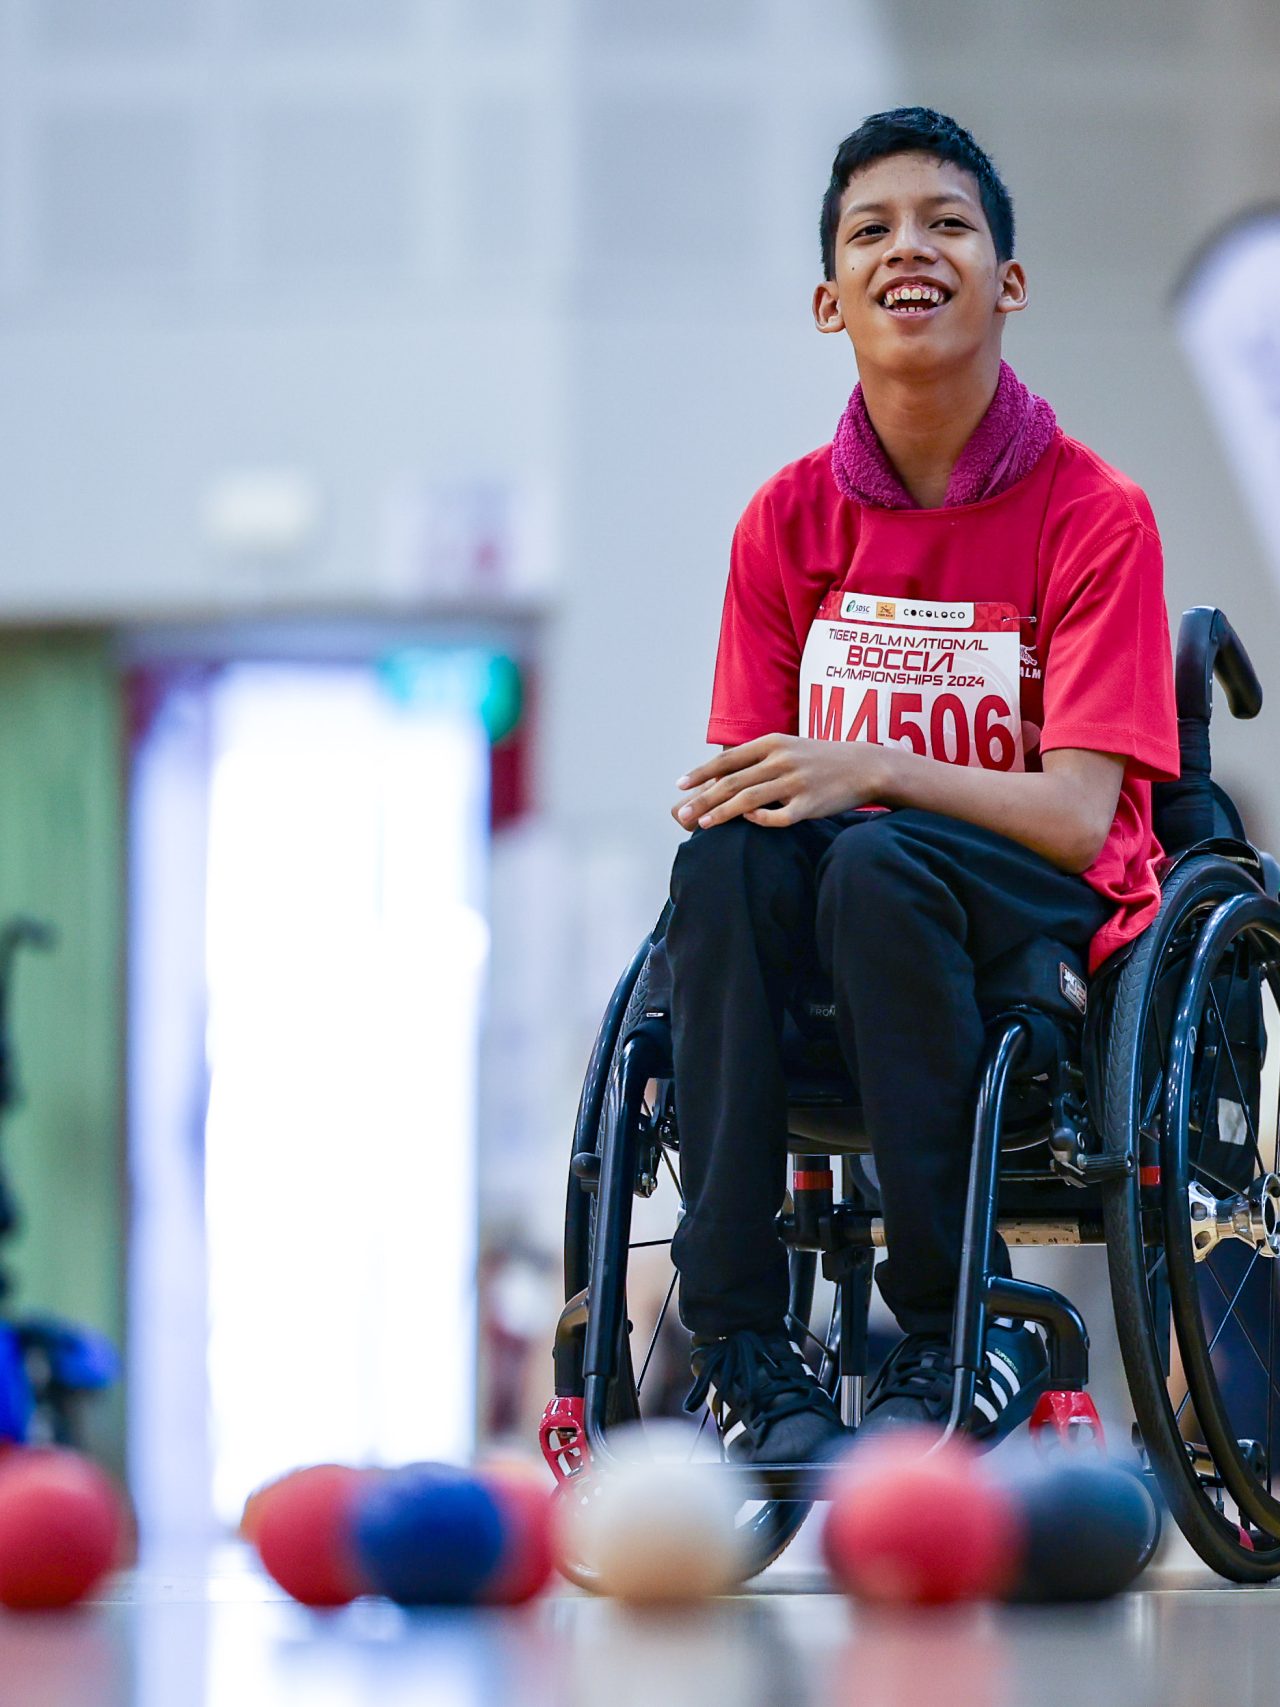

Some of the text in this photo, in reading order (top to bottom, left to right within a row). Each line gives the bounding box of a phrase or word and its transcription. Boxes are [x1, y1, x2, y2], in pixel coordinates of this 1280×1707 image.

[903, 608, 966, 619] COCOLOCO
[829, 628, 989, 651] TIGER BALM NATIONAL
[846, 644, 955, 673] BOCCIA
[826, 666, 985, 688] CHAMPIONSHIPS 2024
[809, 683, 1016, 772] M4506
